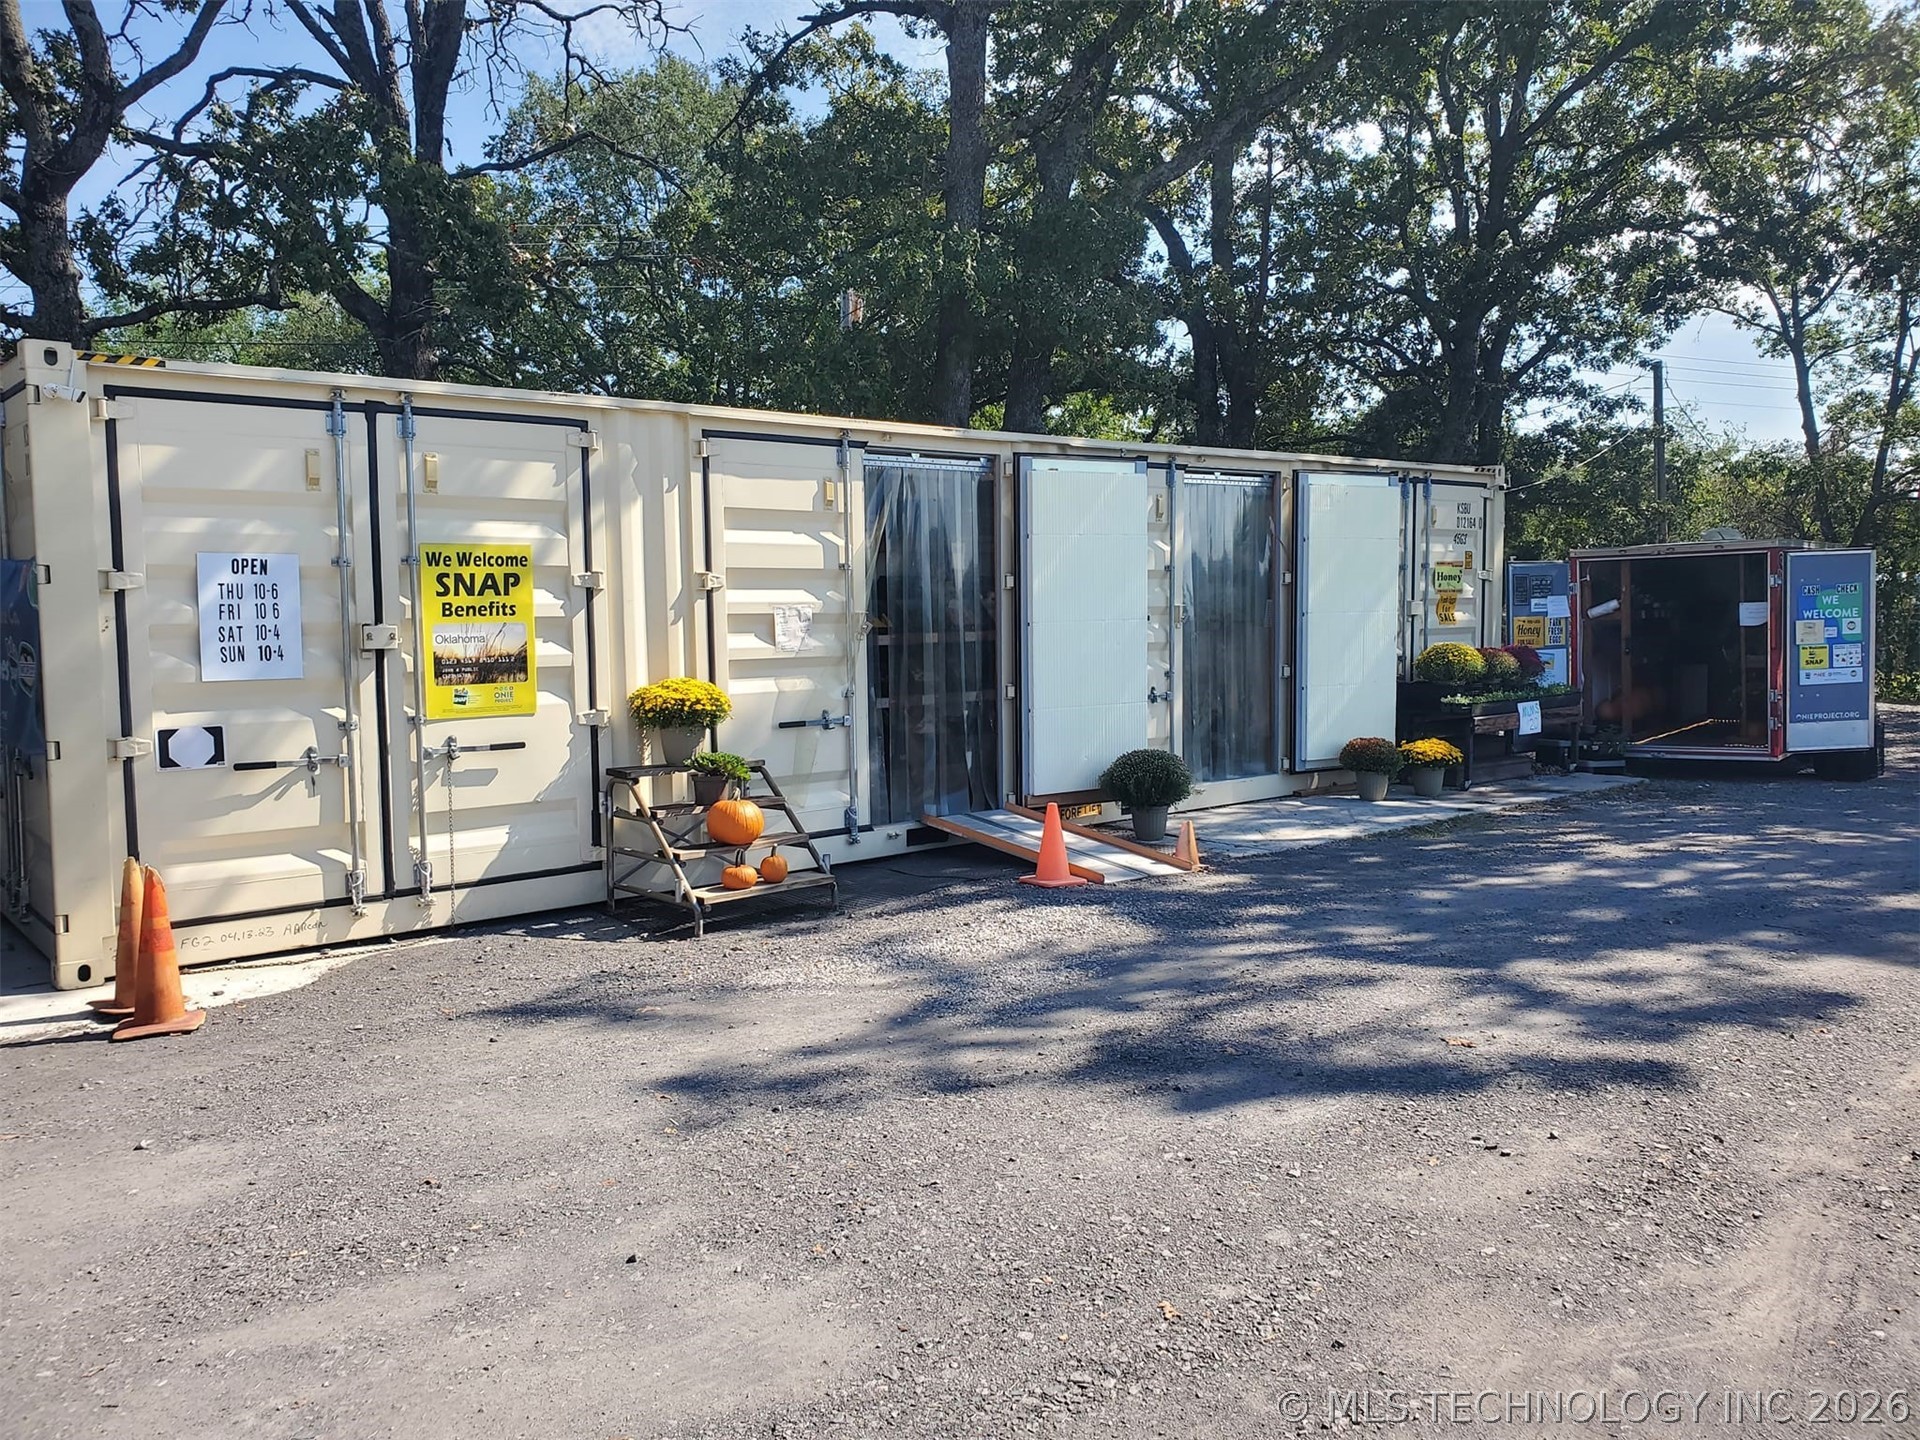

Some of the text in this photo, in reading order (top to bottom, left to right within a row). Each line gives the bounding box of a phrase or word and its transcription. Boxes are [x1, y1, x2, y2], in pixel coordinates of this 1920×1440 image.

[425, 551, 528, 567] We Welcome
[231, 558, 268, 575] OPEN
[1437, 570, 1463, 583] Honey
[217, 582, 279, 600] THU 10-6
[435, 572, 521, 597] SNAP
[1802, 583, 1858, 595] CASH CHECK
[1821, 595, 1840, 605] WE
[219, 602, 280, 620] FRI 10 6
[441, 601, 517, 618] Benefits
[1802, 607, 1860, 619] WELCOME
[1439, 613, 1456, 622] SALE
[218, 624, 280, 643] SAT 10-4
[1517, 624, 1541, 638] Honey
[1548, 626, 1563, 635] FRESH
[434, 634, 486, 645] Oklahoma
[1549, 636, 1562, 644] EGGS
[220, 644, 284, 663] SUN 10-4
[1805, 658, 1824, 666] SNAP
[494, 691, 514, 699] ONIE
